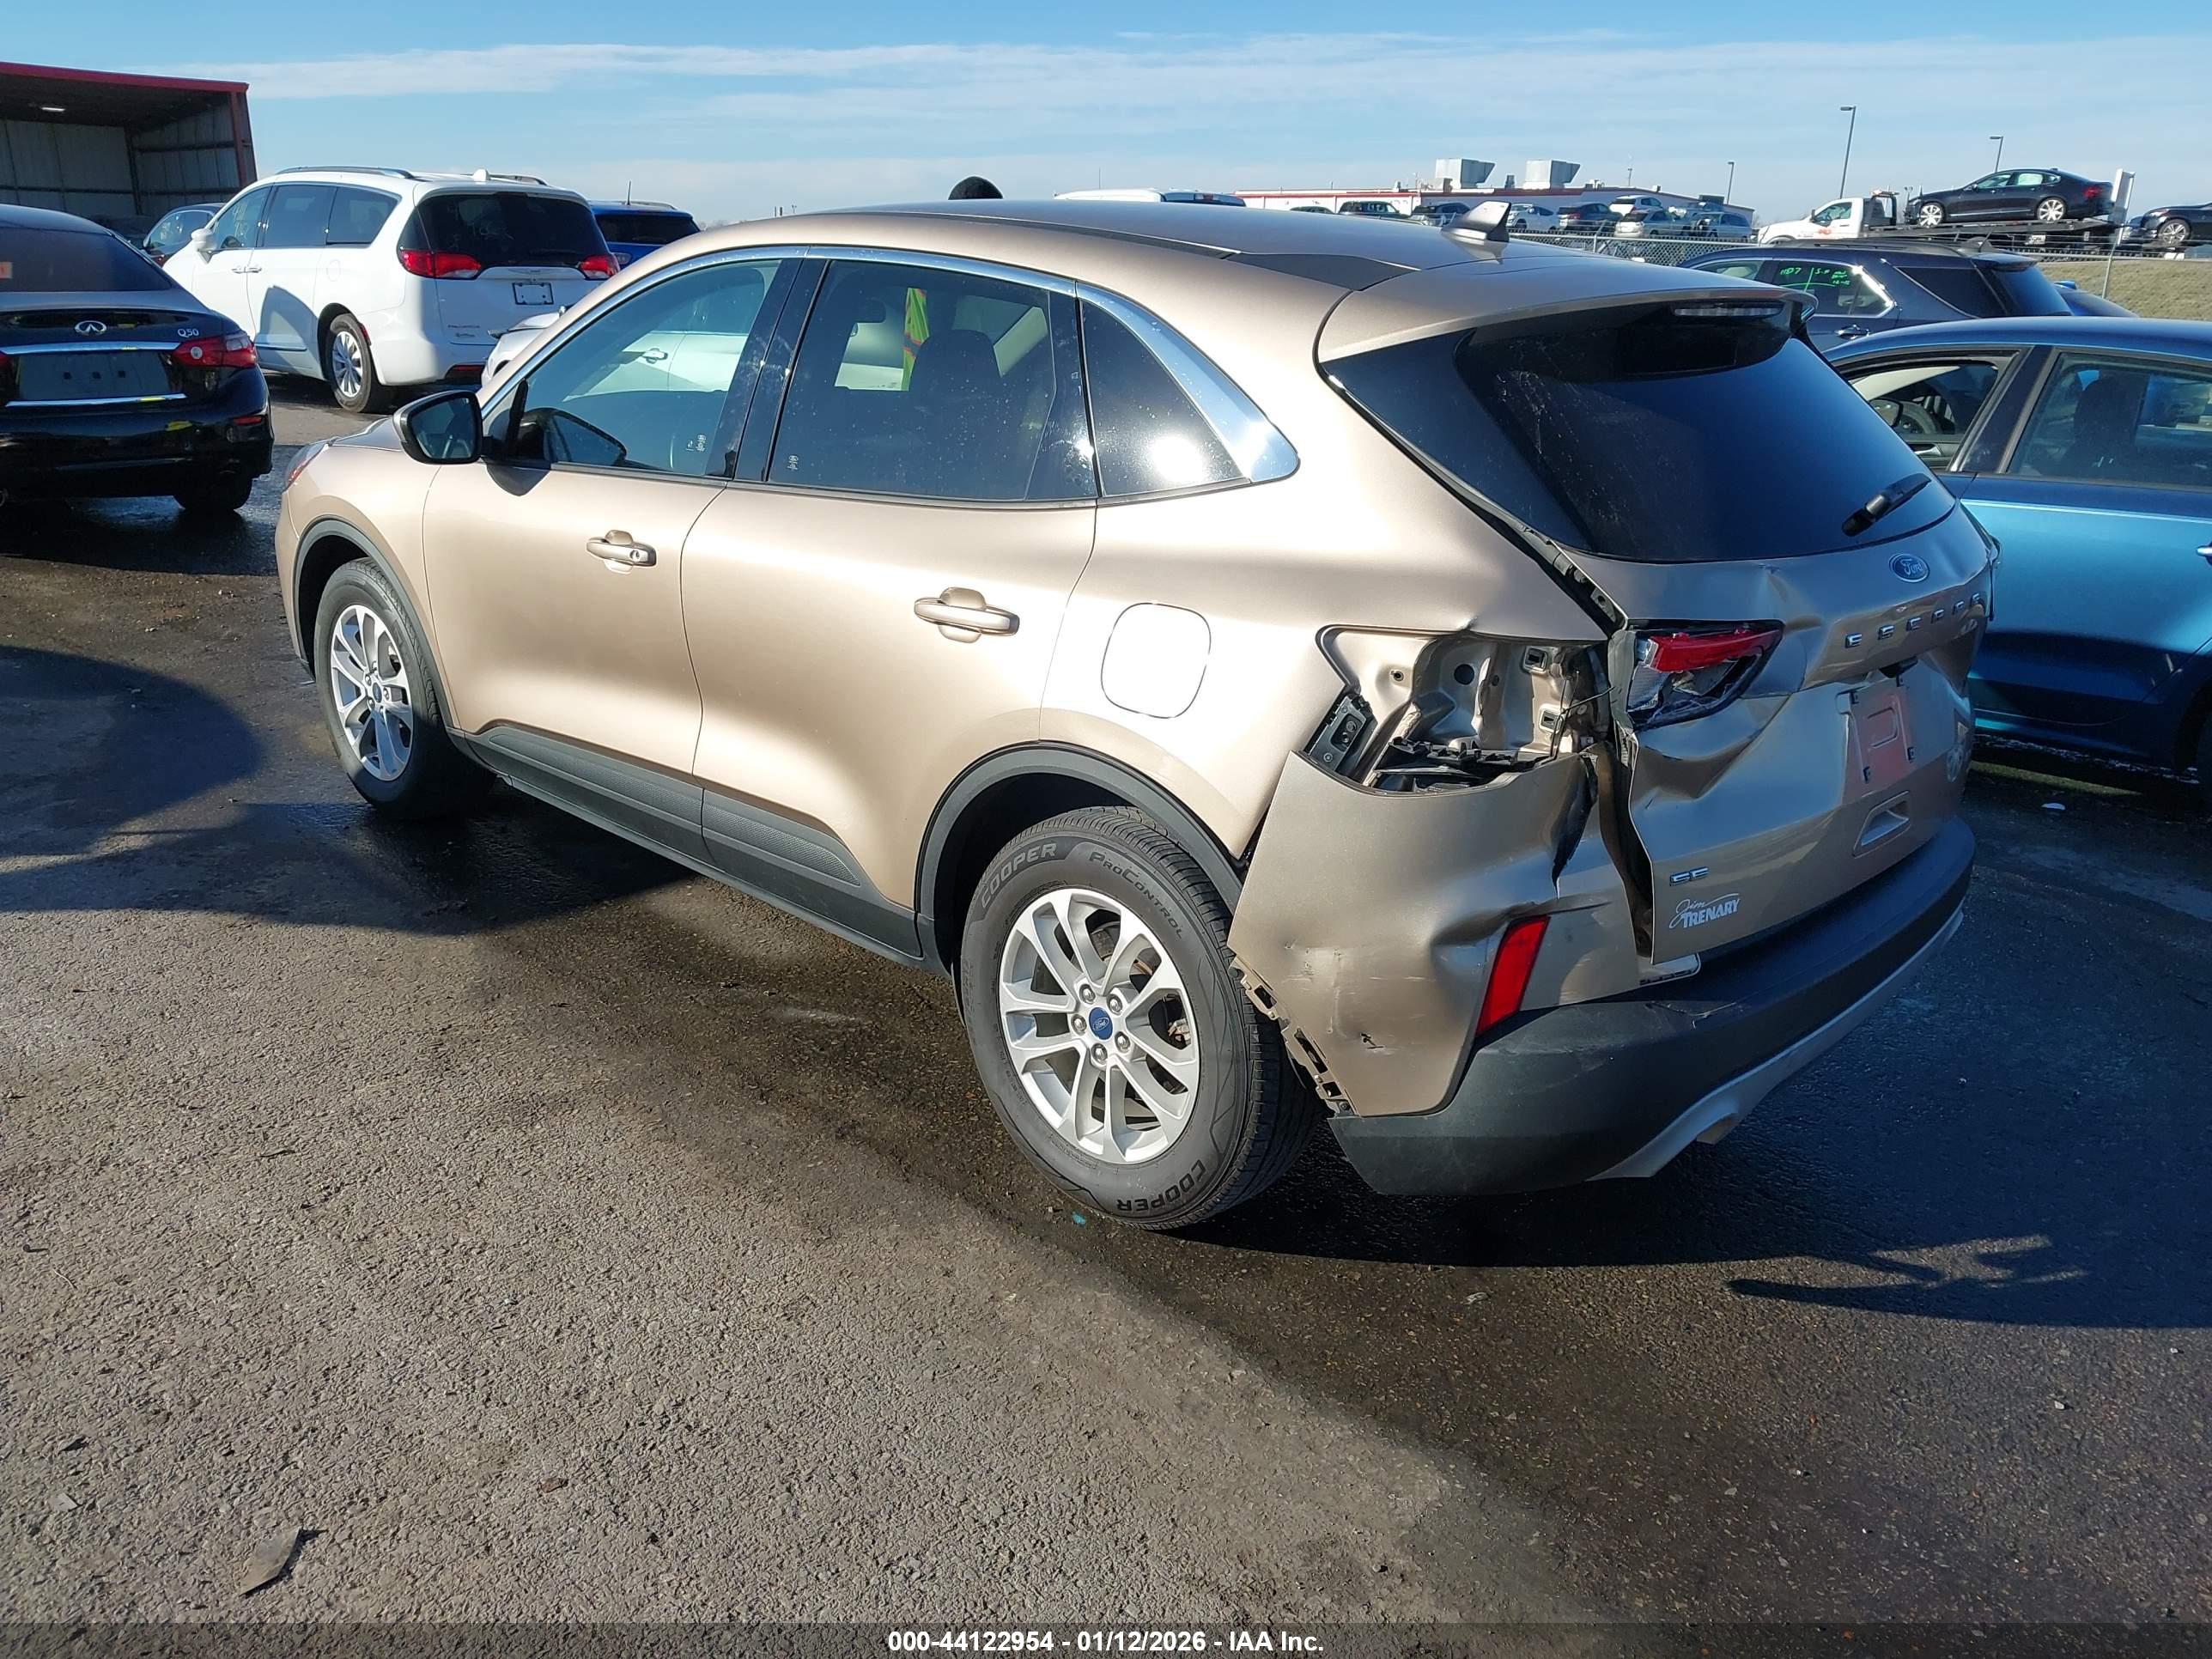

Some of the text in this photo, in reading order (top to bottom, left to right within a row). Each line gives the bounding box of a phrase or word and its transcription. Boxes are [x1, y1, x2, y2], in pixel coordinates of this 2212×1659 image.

[178, 329, 199, 338] Q50
[1845, 592, 1980, 648] ESCAPE
[981, 843, 1057, 908] COOPER
[1681, 898, 1741, 928] TRENARY
[1116, 1159, 1206, 1212] COOPER
